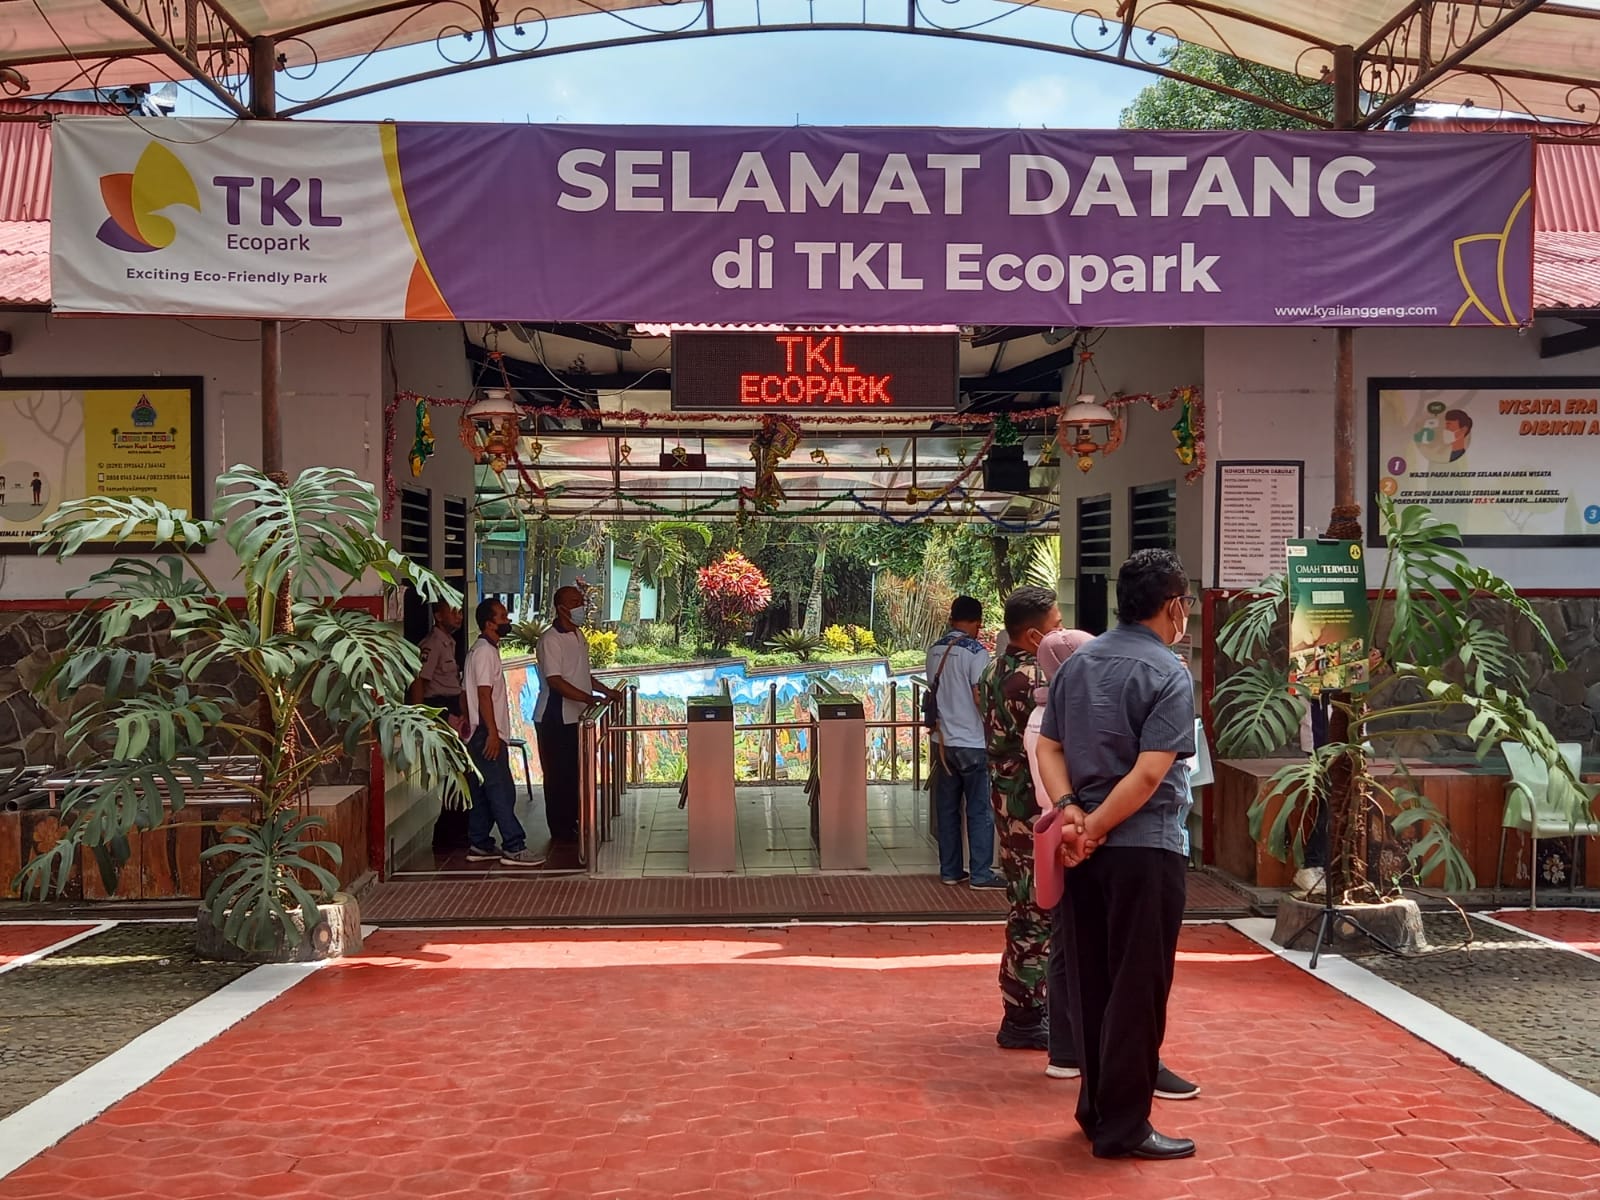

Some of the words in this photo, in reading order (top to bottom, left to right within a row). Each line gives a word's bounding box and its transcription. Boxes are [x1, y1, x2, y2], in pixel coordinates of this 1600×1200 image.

[556, 148, 981, 215] SELAMAT
[1008, 153, 1376, 218] DATANG
[212, 175, 343, 227] TKL
[226, 233, 310, 254] Ecopark
[126, 267, 190, 283] Exciting
[194, 269, 290, 287] Eco-Friendly
[293, 271, 328, 284] Park
[711, 234, 774, 289] di
[794, 242, 924, 290] TKL
[945, 242, 1221, 304] Ecopark
[1274, 304, 1438, 318] www.kyailanggeng.com
[776, 336, 856, 373] TKL
[740, 375, 891, 403] ECOPARK
[1499, 399, 1561, 415] WISATA
[1564, 398, 1598, 414] ERA
[1519, 420, 1586, 435] DIBIKIN
[1295, 564, 1320, 574] OMAH
[1320, 565, 1359, 574] TERWELU
